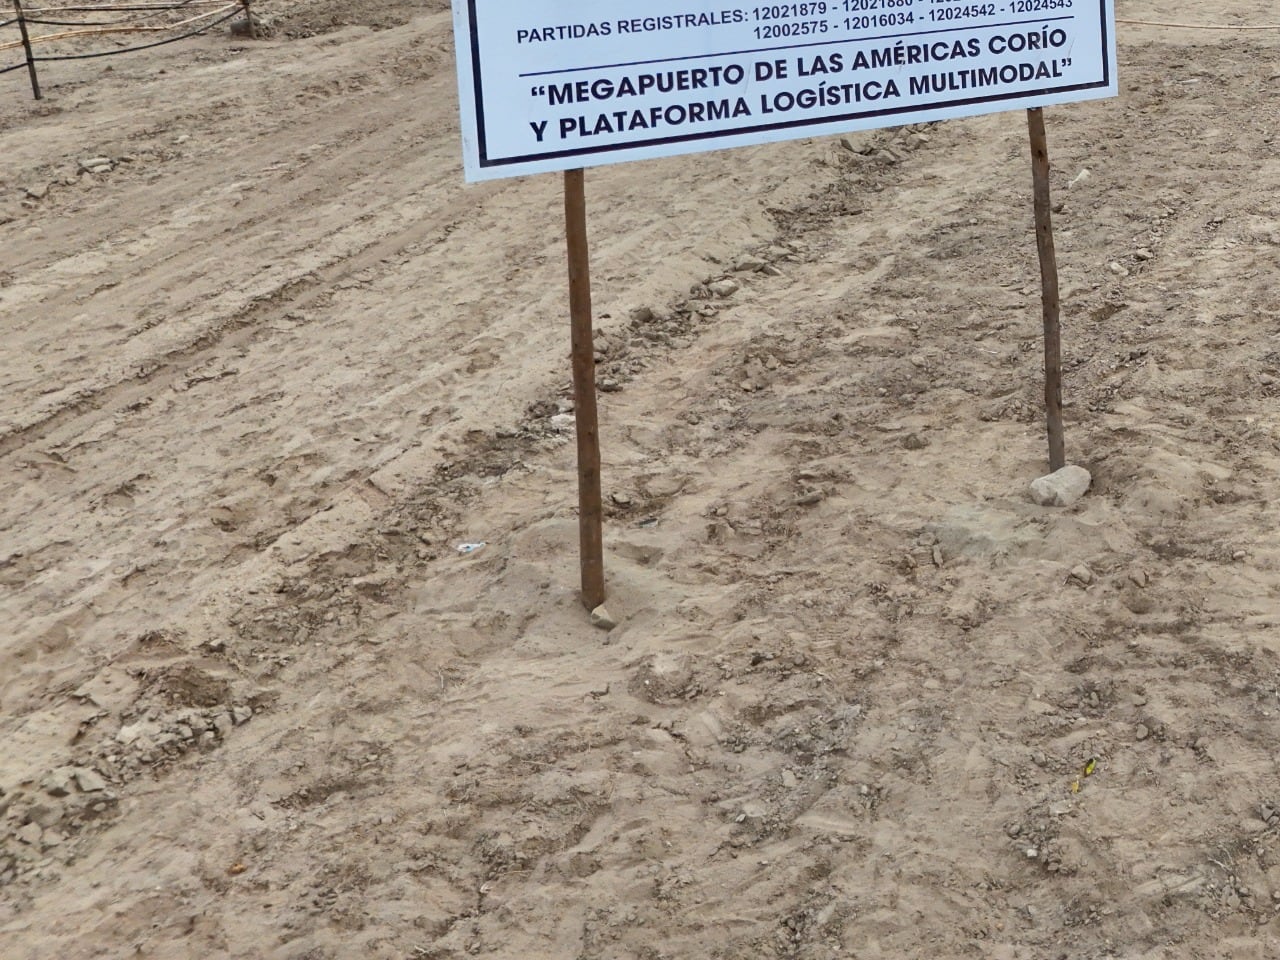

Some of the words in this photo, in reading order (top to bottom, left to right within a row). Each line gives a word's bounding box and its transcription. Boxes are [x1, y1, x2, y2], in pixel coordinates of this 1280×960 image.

[517, 22, 611, 43] PARTIDAS
[618, 10, 748, 33] REGISTRALES:
[752, 1, 828, 21] 12021879
[753, 19, 829, 40] 12002575
[843, 11, 915, 31] 12016034
[928, 3, 996, 22] 12024542
[531, 64, 745, 106] “MEGAPUERTO
[755, 59, 787, 81] DE
[798, 53, 843, 76] LAS
[851, 41, 981, 71] AMÉRICAS
[988, 25, 1067, 54] CORÍO
[530, 121, 547, 142] Y
[559, 97, 752, 139] PLATAFORMA
[761, 81, 901, 114] LOGÍSTICA
[909, 58, 1072, 95] MULTIMODAL”
